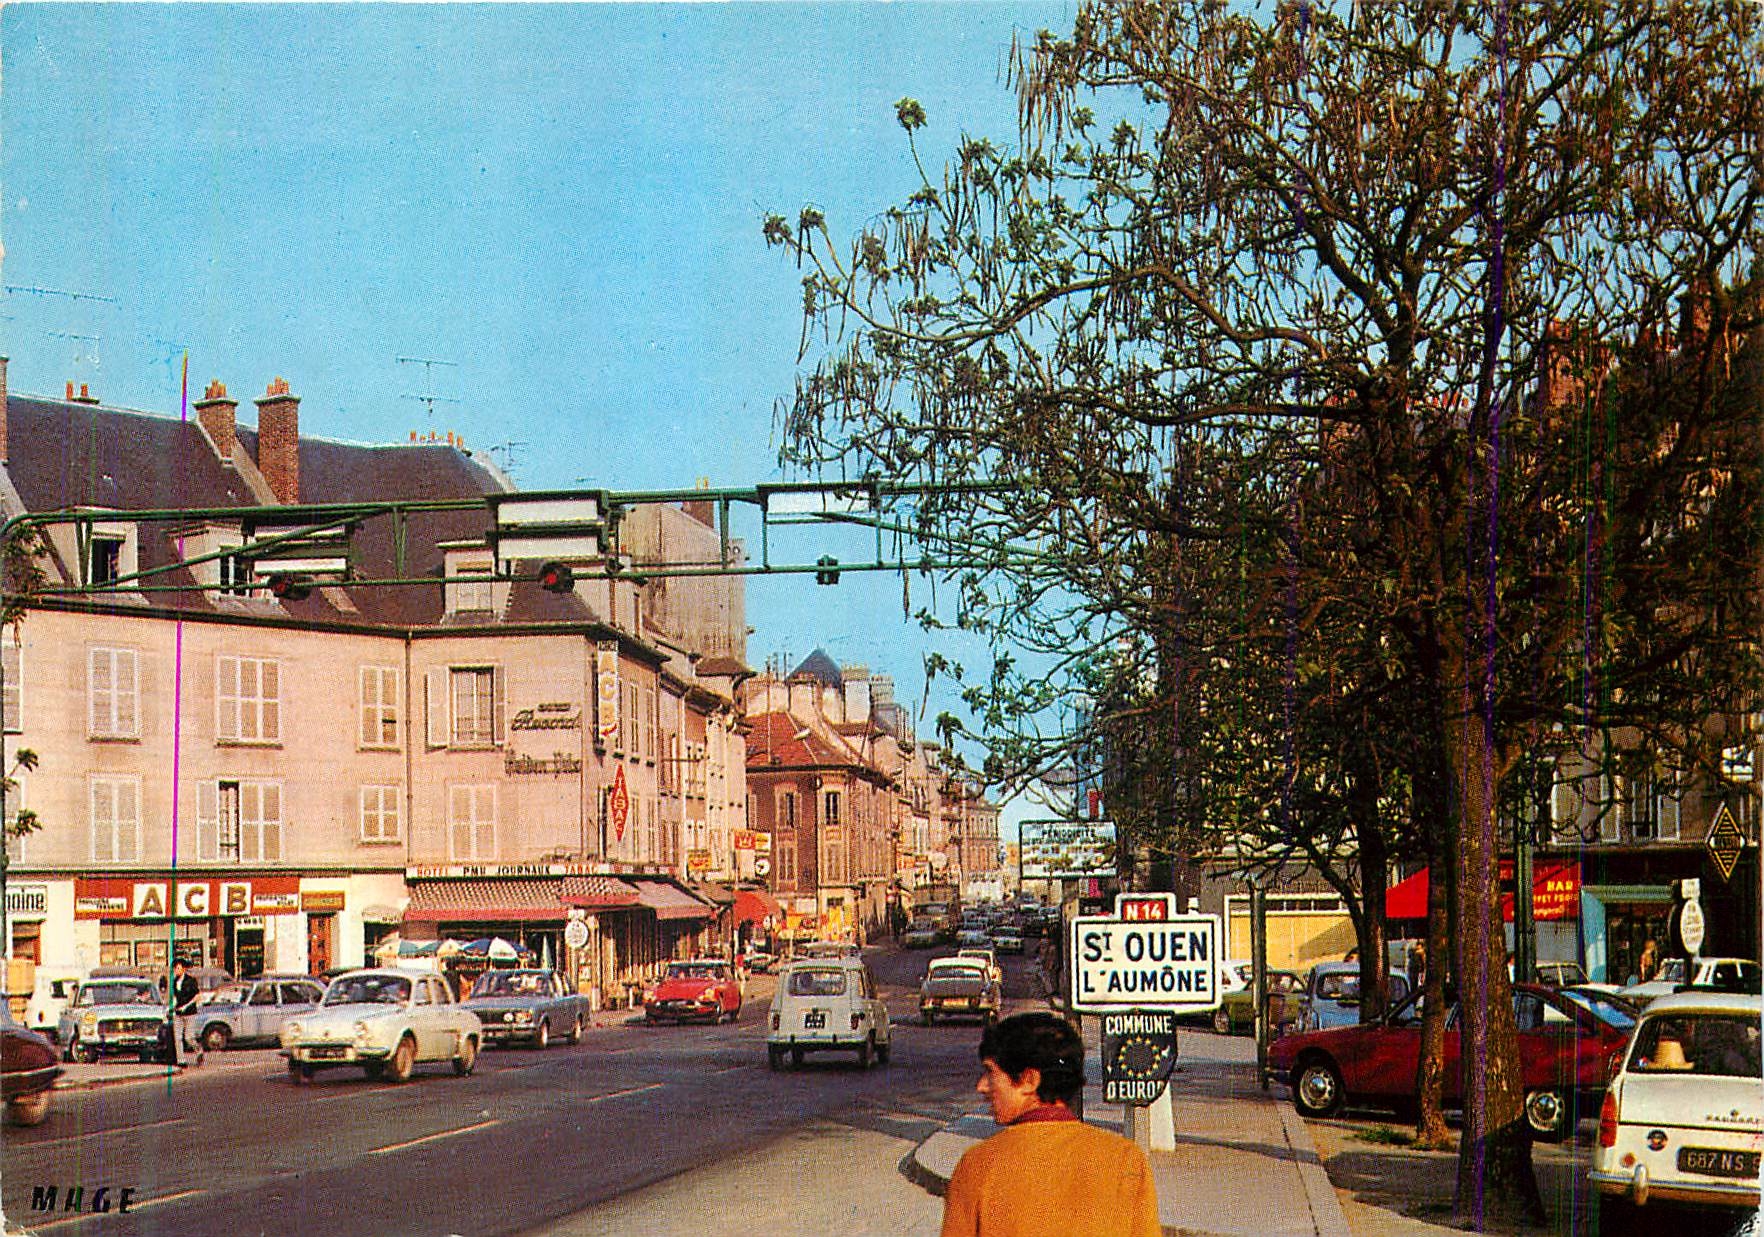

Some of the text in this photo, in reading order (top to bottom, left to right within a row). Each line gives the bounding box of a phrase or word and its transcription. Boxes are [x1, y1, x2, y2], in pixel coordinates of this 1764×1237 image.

[613, 777, 626, 832] TABAC
[463, 866, 486, 876] PMU
[498, 864, 550, 876] JOURNAUX
[1126, 903, 1161, 920] N 14
[1125, 931, 1207, 962] OUEN
[1084, 965, 1207, 993] L'AUMÔNE
[1105, 1015, 1172, 1034] COMMUNE
